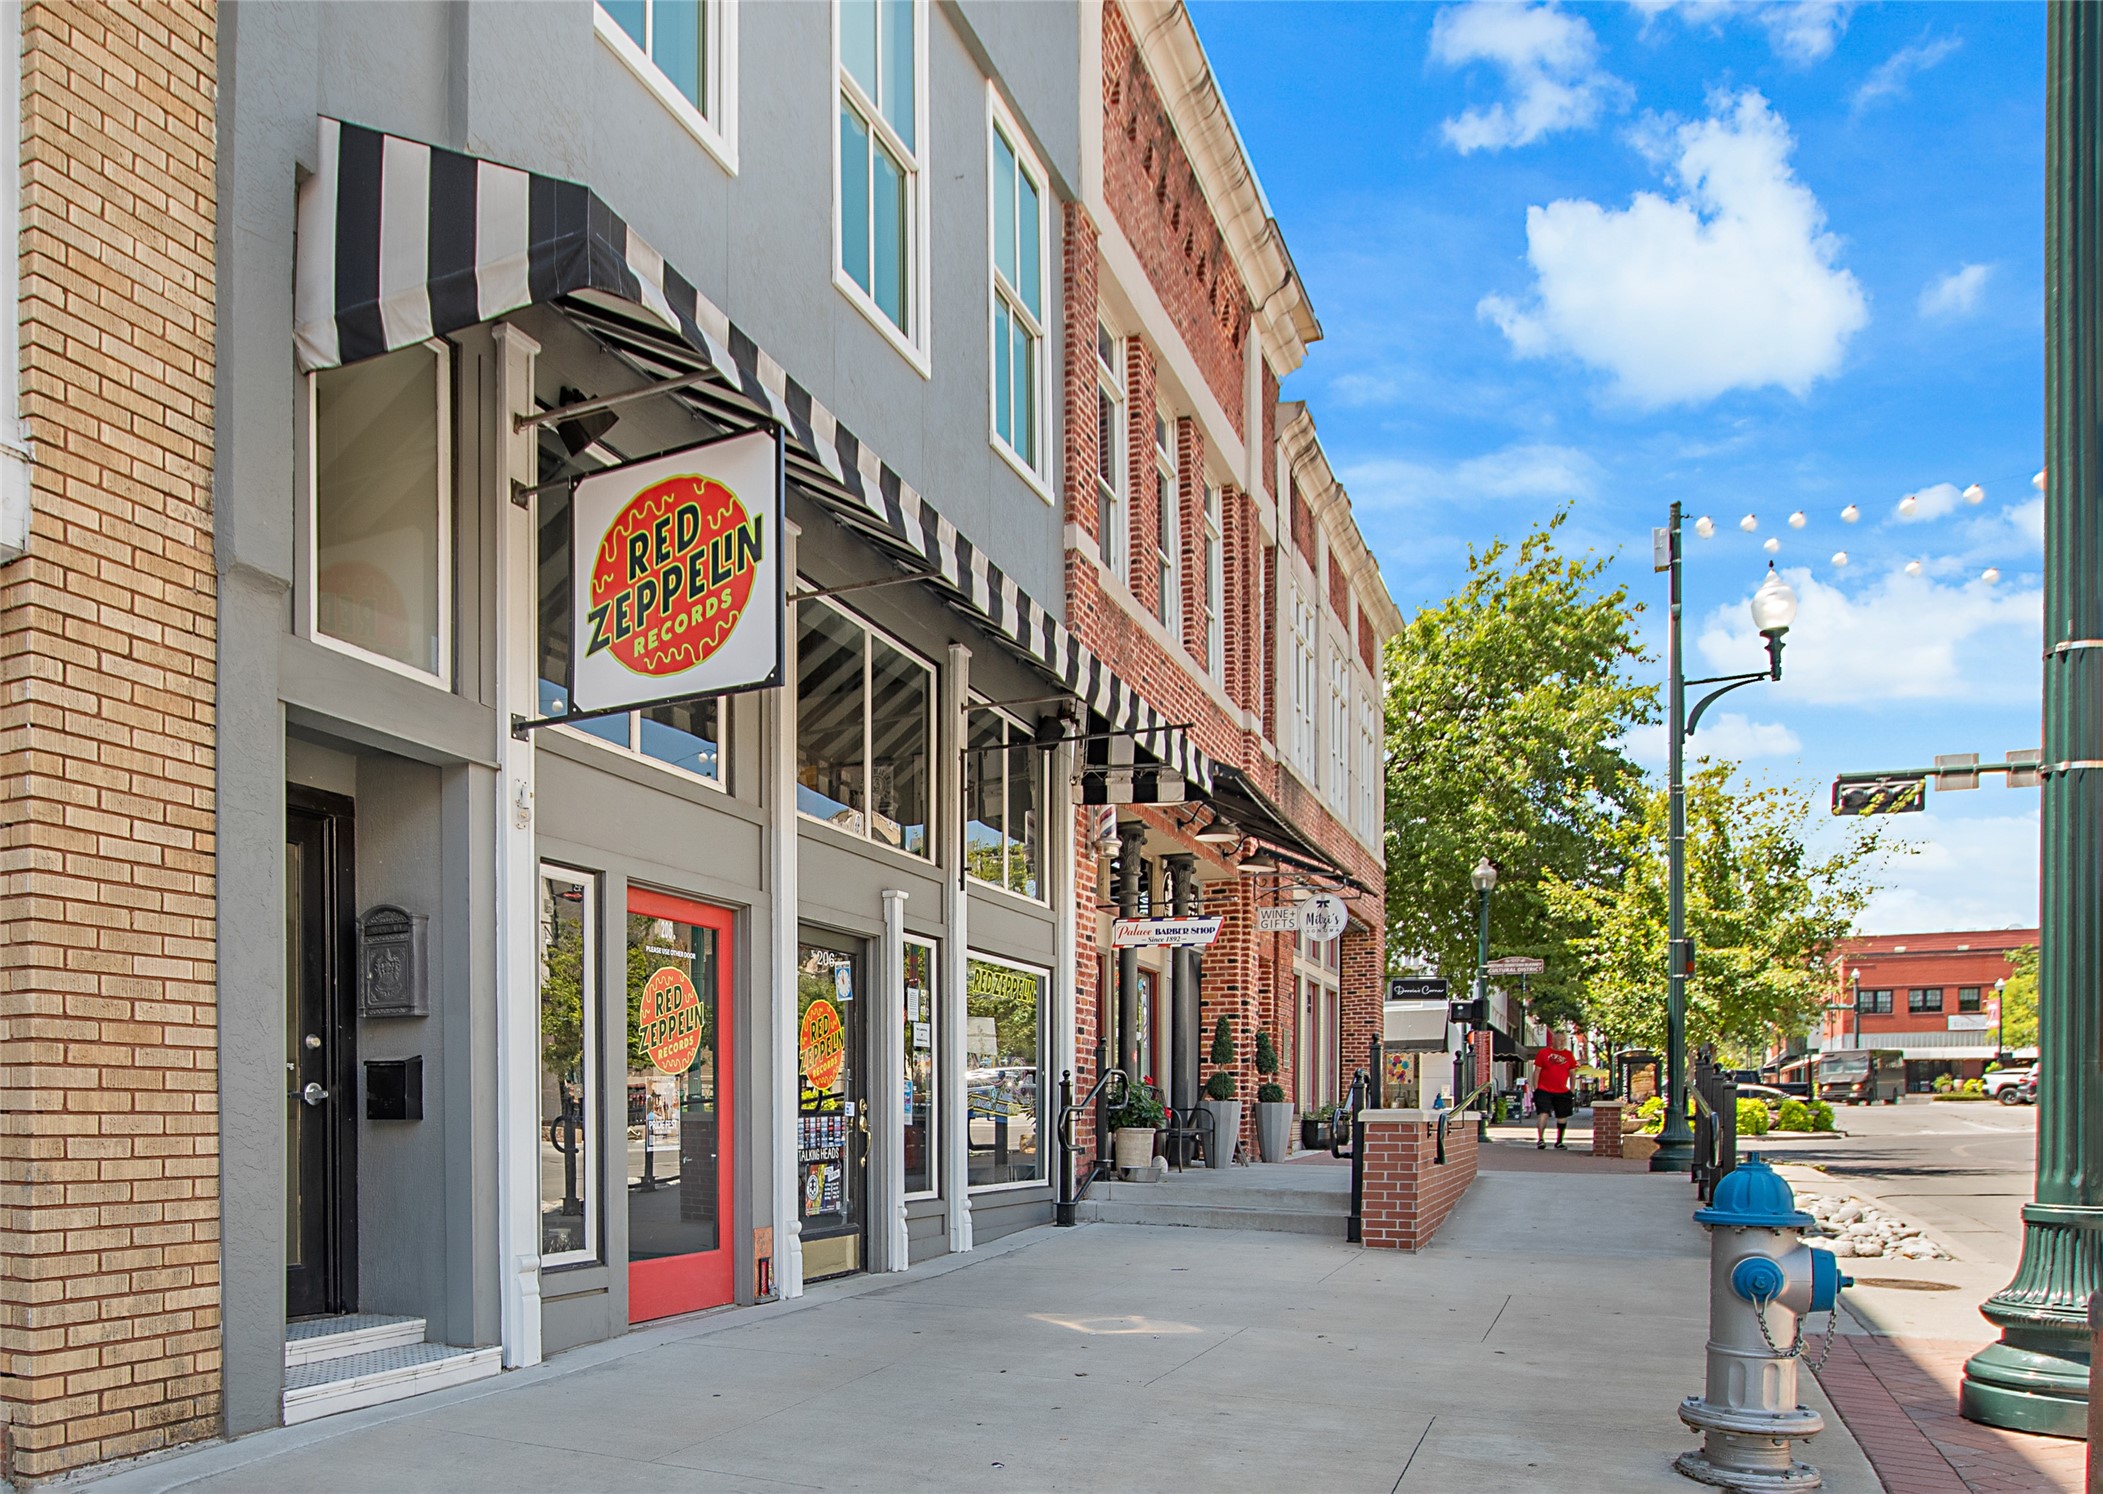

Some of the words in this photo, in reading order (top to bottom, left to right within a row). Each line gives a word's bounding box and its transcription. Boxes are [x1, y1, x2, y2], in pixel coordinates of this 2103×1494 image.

[626, 502, 700, 583] RED
[585, 513, 764, 658] ZEPPELIN
[634, 588, 732, 657] RECORDS
[660, 921, 673, 938] 206
[1117, 924, 1152, 939] Palace
[1155, 927, 1189, 935] BARBER
[1260, 918, 1295, 929] GIFTS
[1306, 912, 1339, 930] Mitzi's
[645, 945, 661, 954] PLEASE
[662, 948, 670, 956] USE
[670, 949, 683, 958] OTHER
[684, 952, 696, 960] DOOR
[817, 951, 835, 967] 206
[973, 967, 993, 995] RED
[992, 972, 1036, 1004] ZEPPELIN
[655, 984, 683, 1018] RED
[638, 1002, 704, 1054] ZEPPELIN
[810, 1013, 831, 1042] RED
[658, 1035, 694, 1060] RECORDS
[799, 1027, 844, 1075] ZEPPELIN
[812, 1055, 838, 1079] RECORDS
[649, 1120, 664, 1130] PRIDE
[665, 1120, 677, 1129] FEST
[798, 1148, 819, 1162] TALKING
[821, 1147, 840, 1159] HEADS
